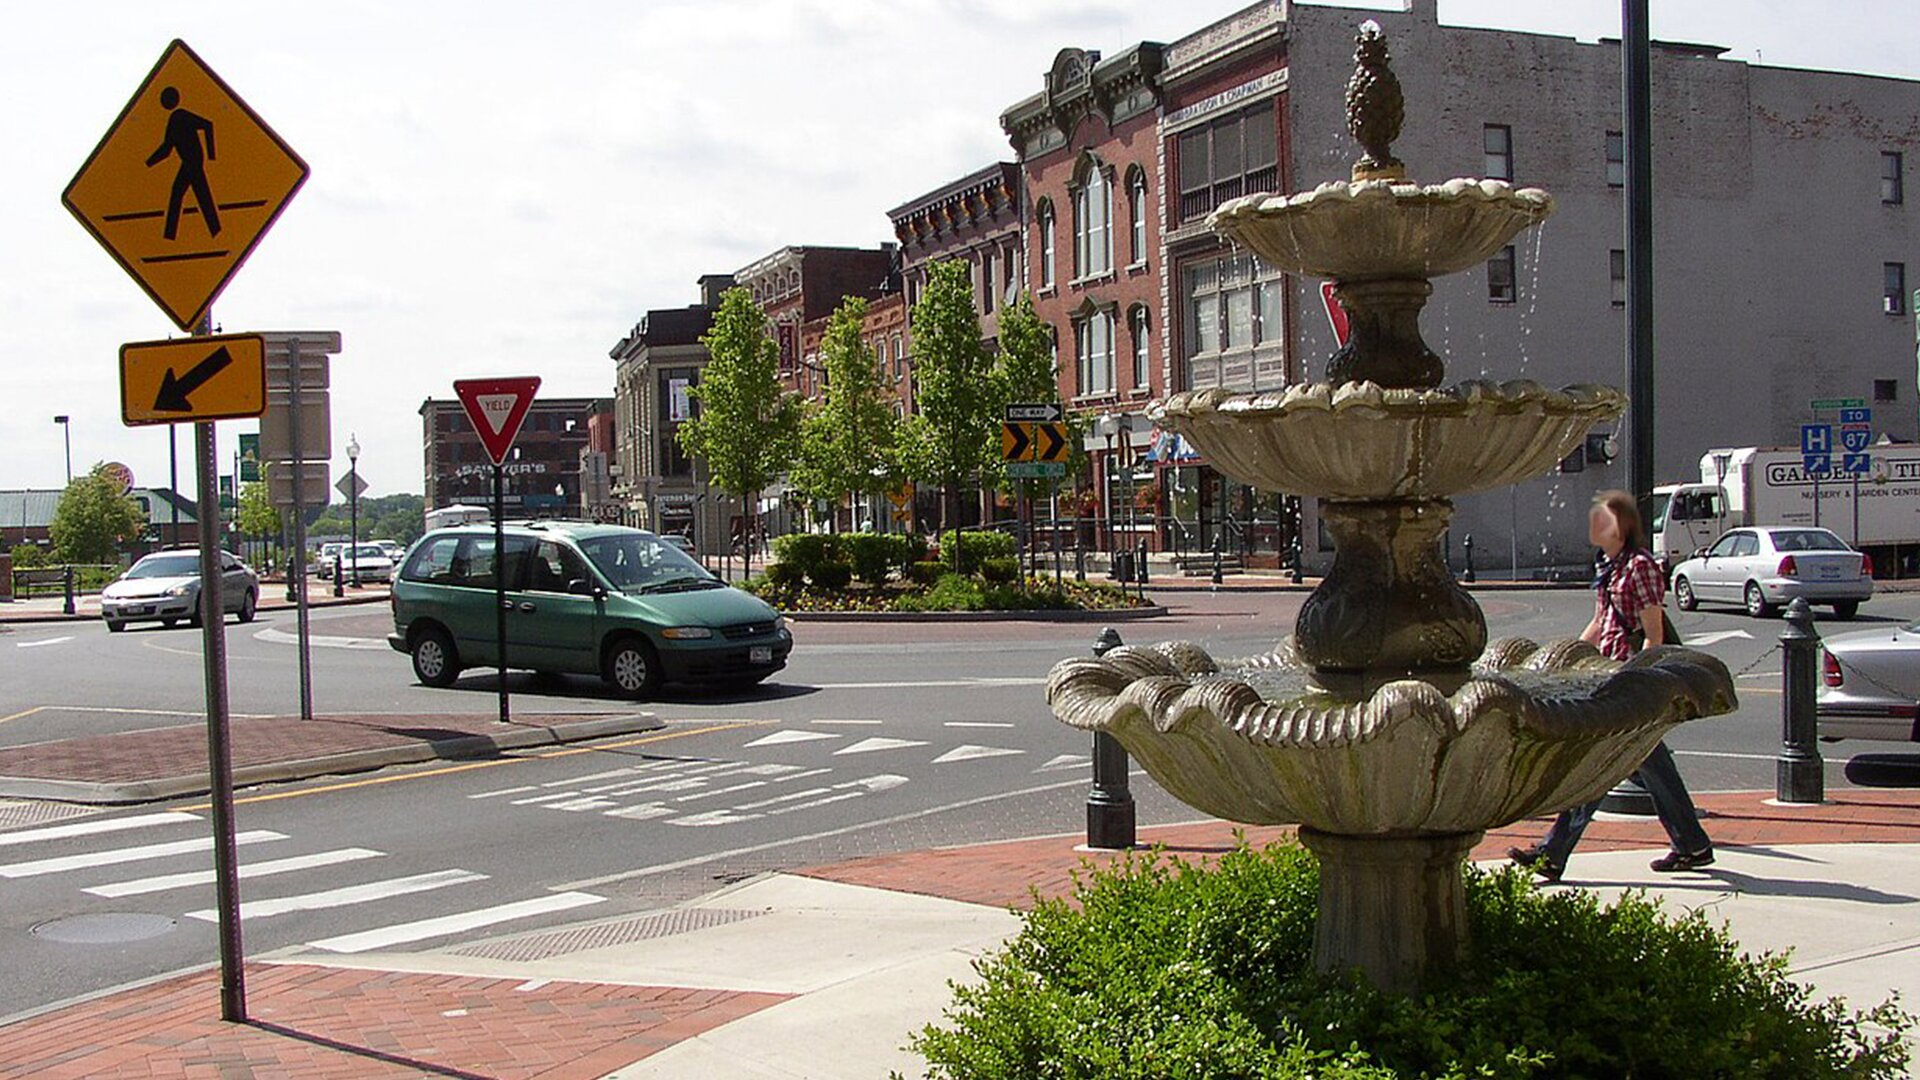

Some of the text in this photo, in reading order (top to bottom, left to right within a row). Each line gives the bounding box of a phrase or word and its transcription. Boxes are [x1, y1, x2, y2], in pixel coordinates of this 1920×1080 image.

[1226, 80, 1264, 100] CHAPMAN
[485, 400, 510, 411] YIELD
[1029, 409, 1045, 417] WAY
[1848, 411, 1864, 420] TO
[1807, 428, 1826, 450] H
[1846, 433, 1867, 447] 87
[1895, 463, 1920, 478] TI
[1801, 490, 1840, 499] NUSERY
[1845, 490, 1851, 498] &
